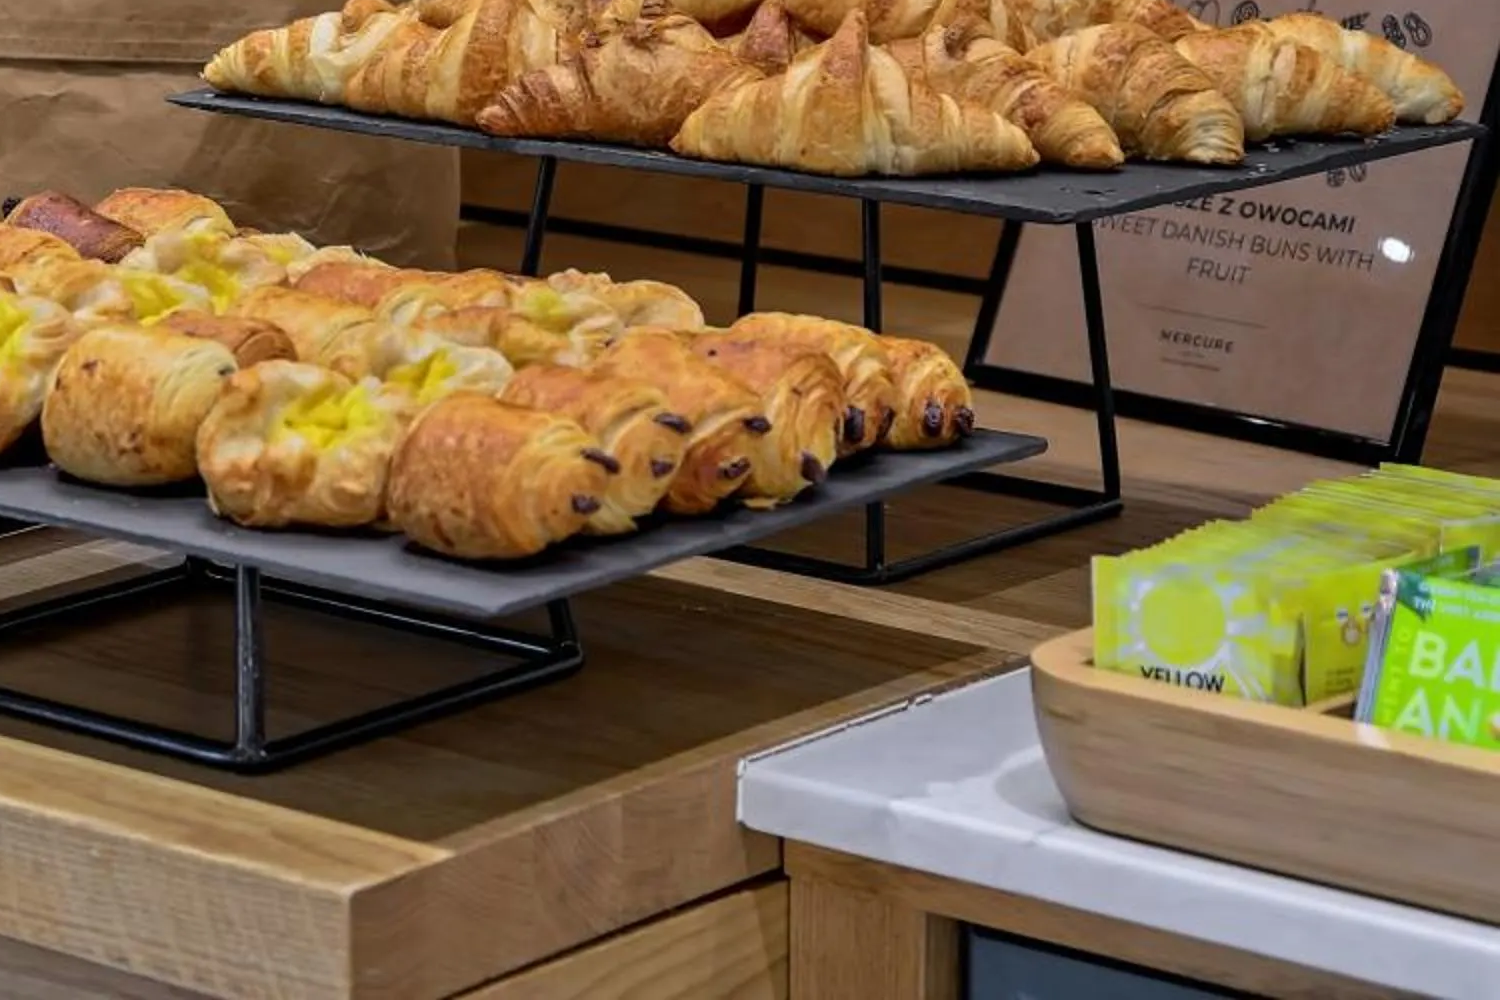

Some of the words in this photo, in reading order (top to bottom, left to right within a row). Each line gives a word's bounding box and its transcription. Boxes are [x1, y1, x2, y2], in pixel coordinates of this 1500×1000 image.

[1218, 197, 1235, 216] Z
[1239, 201, 1356, 233] OWOCAMI
[1161, 220, 1245, 250] DANISH
[1250, 235, 1311, 262] BUNS
[1316, 247, 1375, 272] WITH
[1186, 257, 1253, 285] FRUIT
[1159, 329, 1235, 353] MERCURE
